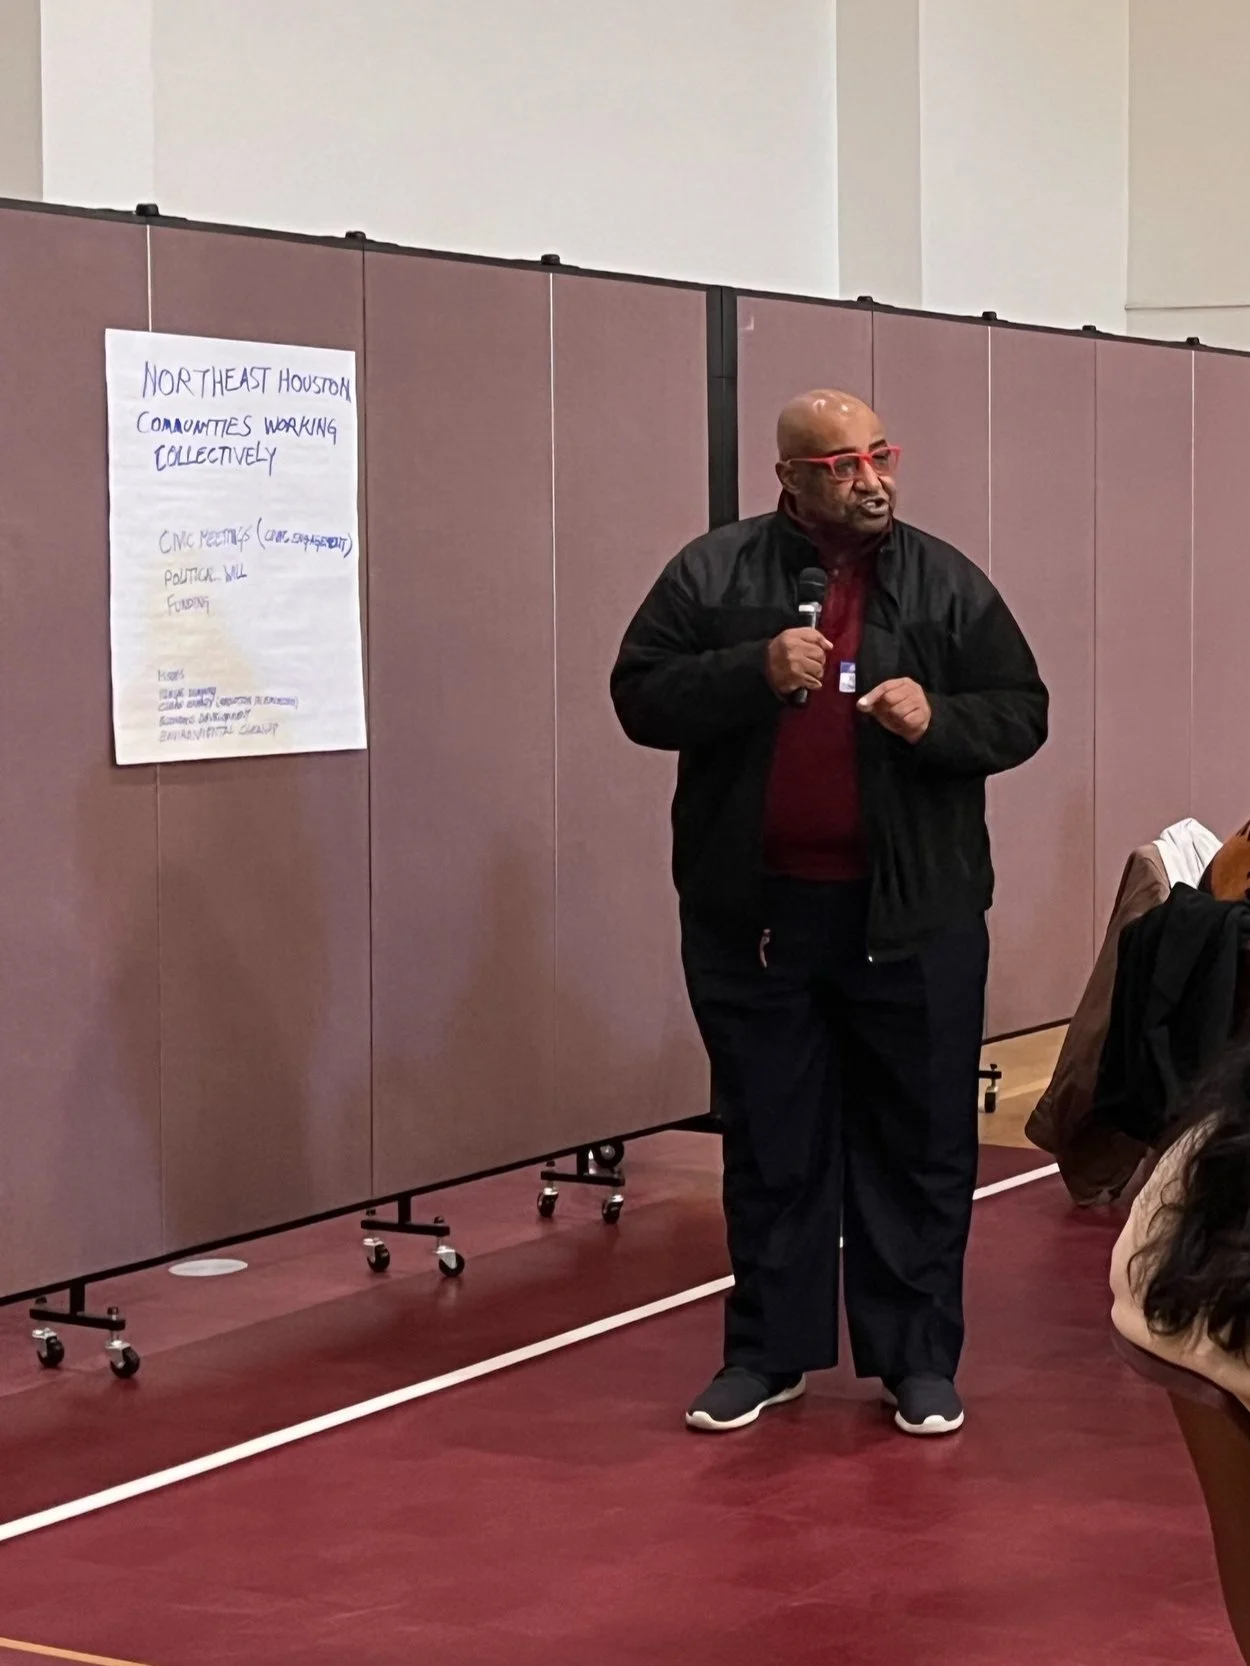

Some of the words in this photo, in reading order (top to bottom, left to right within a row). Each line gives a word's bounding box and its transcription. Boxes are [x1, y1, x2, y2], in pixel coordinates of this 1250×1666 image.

[142, 361, 272, 398] NORTHEAST
[278, 367, 352, 403] HOUSTON
[264, 416, 337, 445] WORKING
[154, 441, 277, 477] COLLECTIVELY
[159, 530, 195, 554] CIVIC
[164, 567, 221, 588] POLITICAL
[224, 562, 248, 582] WILL
[167, 594, 210, 616] FUNDING
